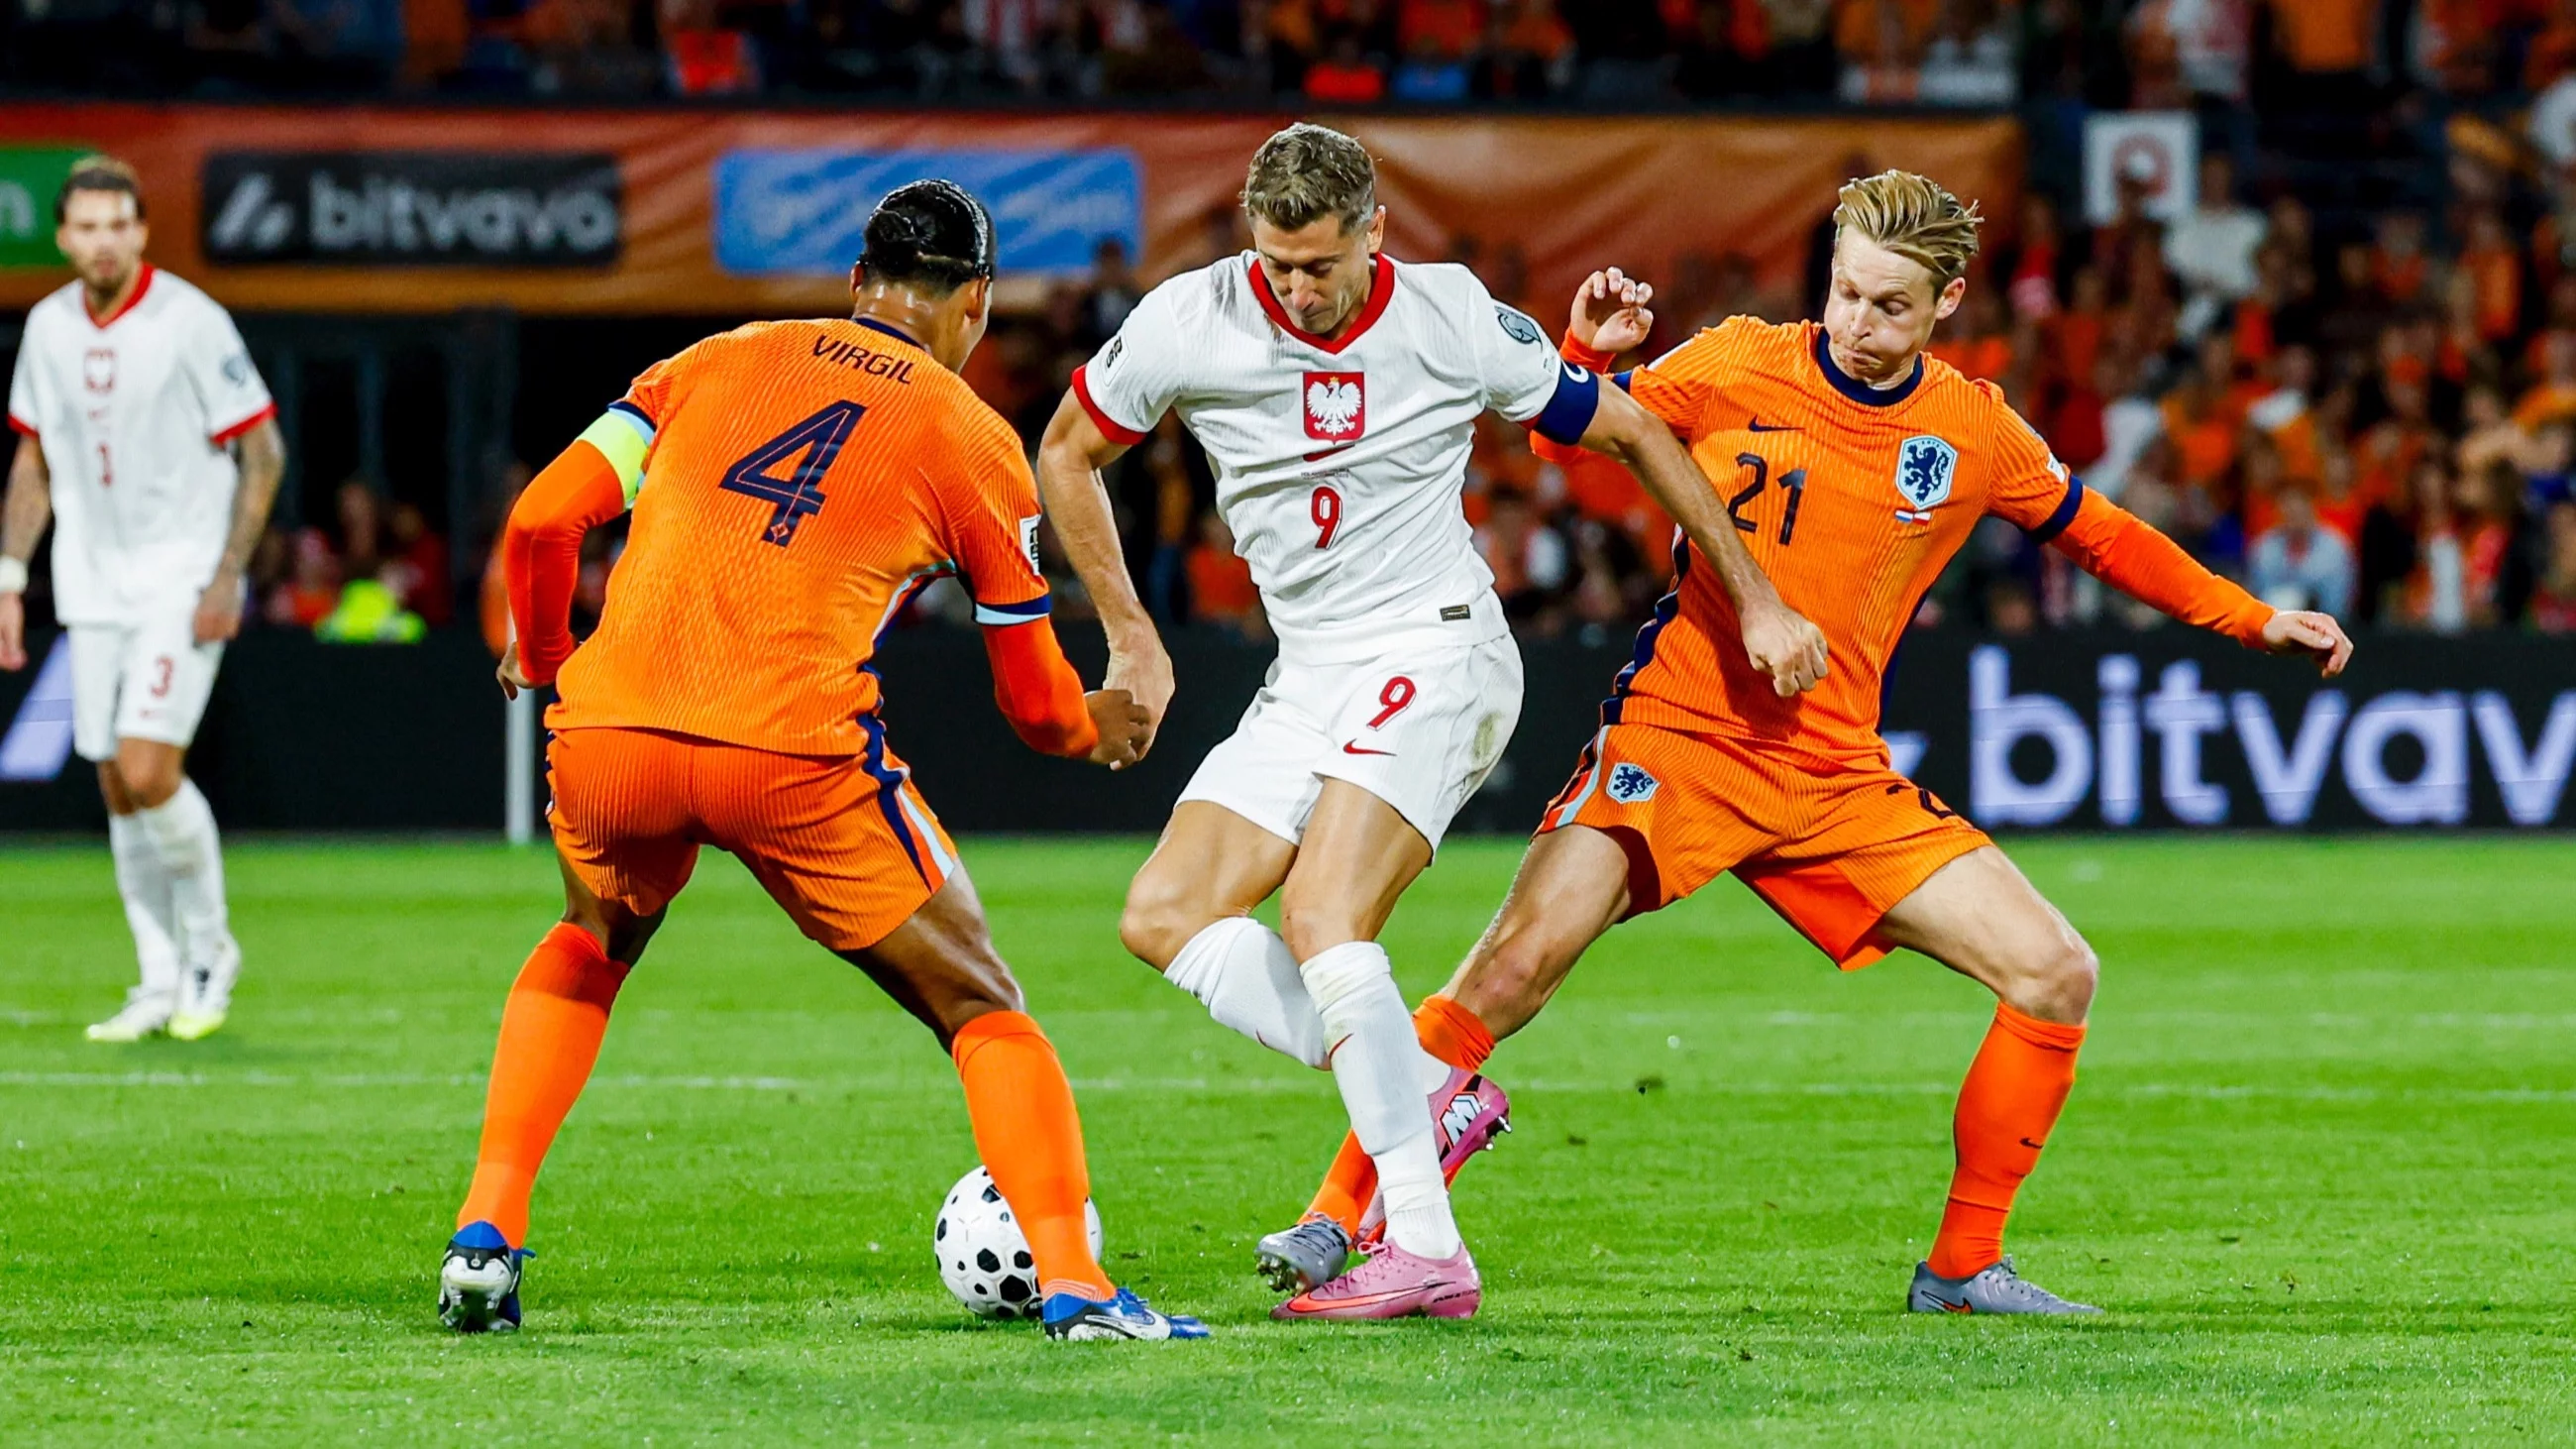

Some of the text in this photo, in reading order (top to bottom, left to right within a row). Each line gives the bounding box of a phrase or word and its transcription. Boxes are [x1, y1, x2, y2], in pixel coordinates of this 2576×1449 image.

[311, 168, 617, 254] bitvavo
[812, 336, 913, 384] VIRGIL
[719, 399, 867, 547] 4
[1728, 452, 1806, 545] 21
[1311, 486, 1343, 549] 9
[151, 656, 174, 698] 3
[1366, 676, 1417, 731] 9
[1970, 645, 2576, 825] bitvav
